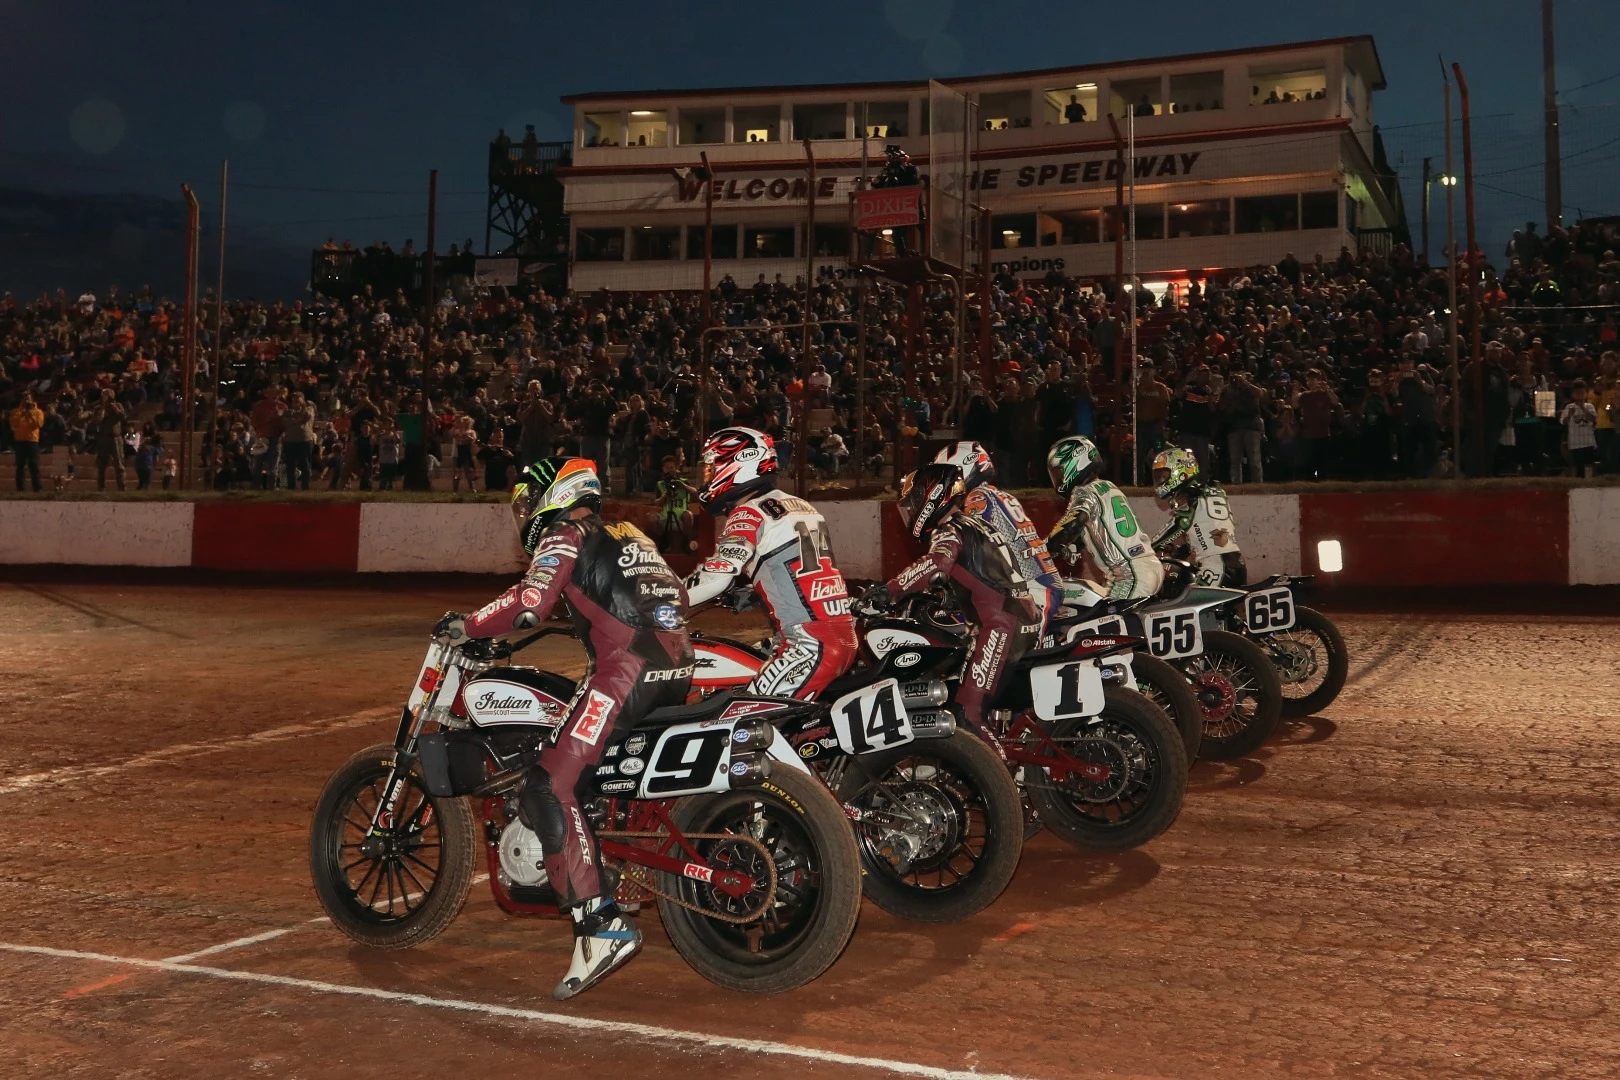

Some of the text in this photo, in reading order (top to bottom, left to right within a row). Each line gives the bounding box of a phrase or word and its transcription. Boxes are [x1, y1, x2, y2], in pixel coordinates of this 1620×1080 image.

[678, 177, 838, 201] WELCOME
[1016, 152, 1201, 187] SPEEDWAY
[860, 194, 916, 215] DIXIE
[739, 451, 757, 460] Arai
[1206, 496, 1229, 520] 6
[1193, 522, 1208, 552] vanson
[622, 566, 664, 579] MOTORCYCLE
[898, 558, 933, 587] Indian
[640, 582, 680, 599] Be Legendary
[477, 592, 516, 622] MOTUL
[1248, 590, 1291, 631] 65
[1092, 638, 1116, 647] Allstate
[1151, 612, 1196, 657] 55
[643, 664, 694, 683] DAINESE
[899, 654, 918, 665] Arai
[971, 629, 1000, 688] Indian
[985, 632, 1009, 691] MOTORCYCLE RACING
[474, 691, 533, 711] Indian
[1054, 663, 1083, 716] 1
[574, 694, 607, 739] RK
[841, 684, 909, 755] 14
[647, 728, 732, 794] 9
[602, 781, 636, 791] COMETIC
[760, 781, 806, 815] DUNLOP
[570, 806, 593, 867] DAINESE
[685, 864, 711, 882] RK
